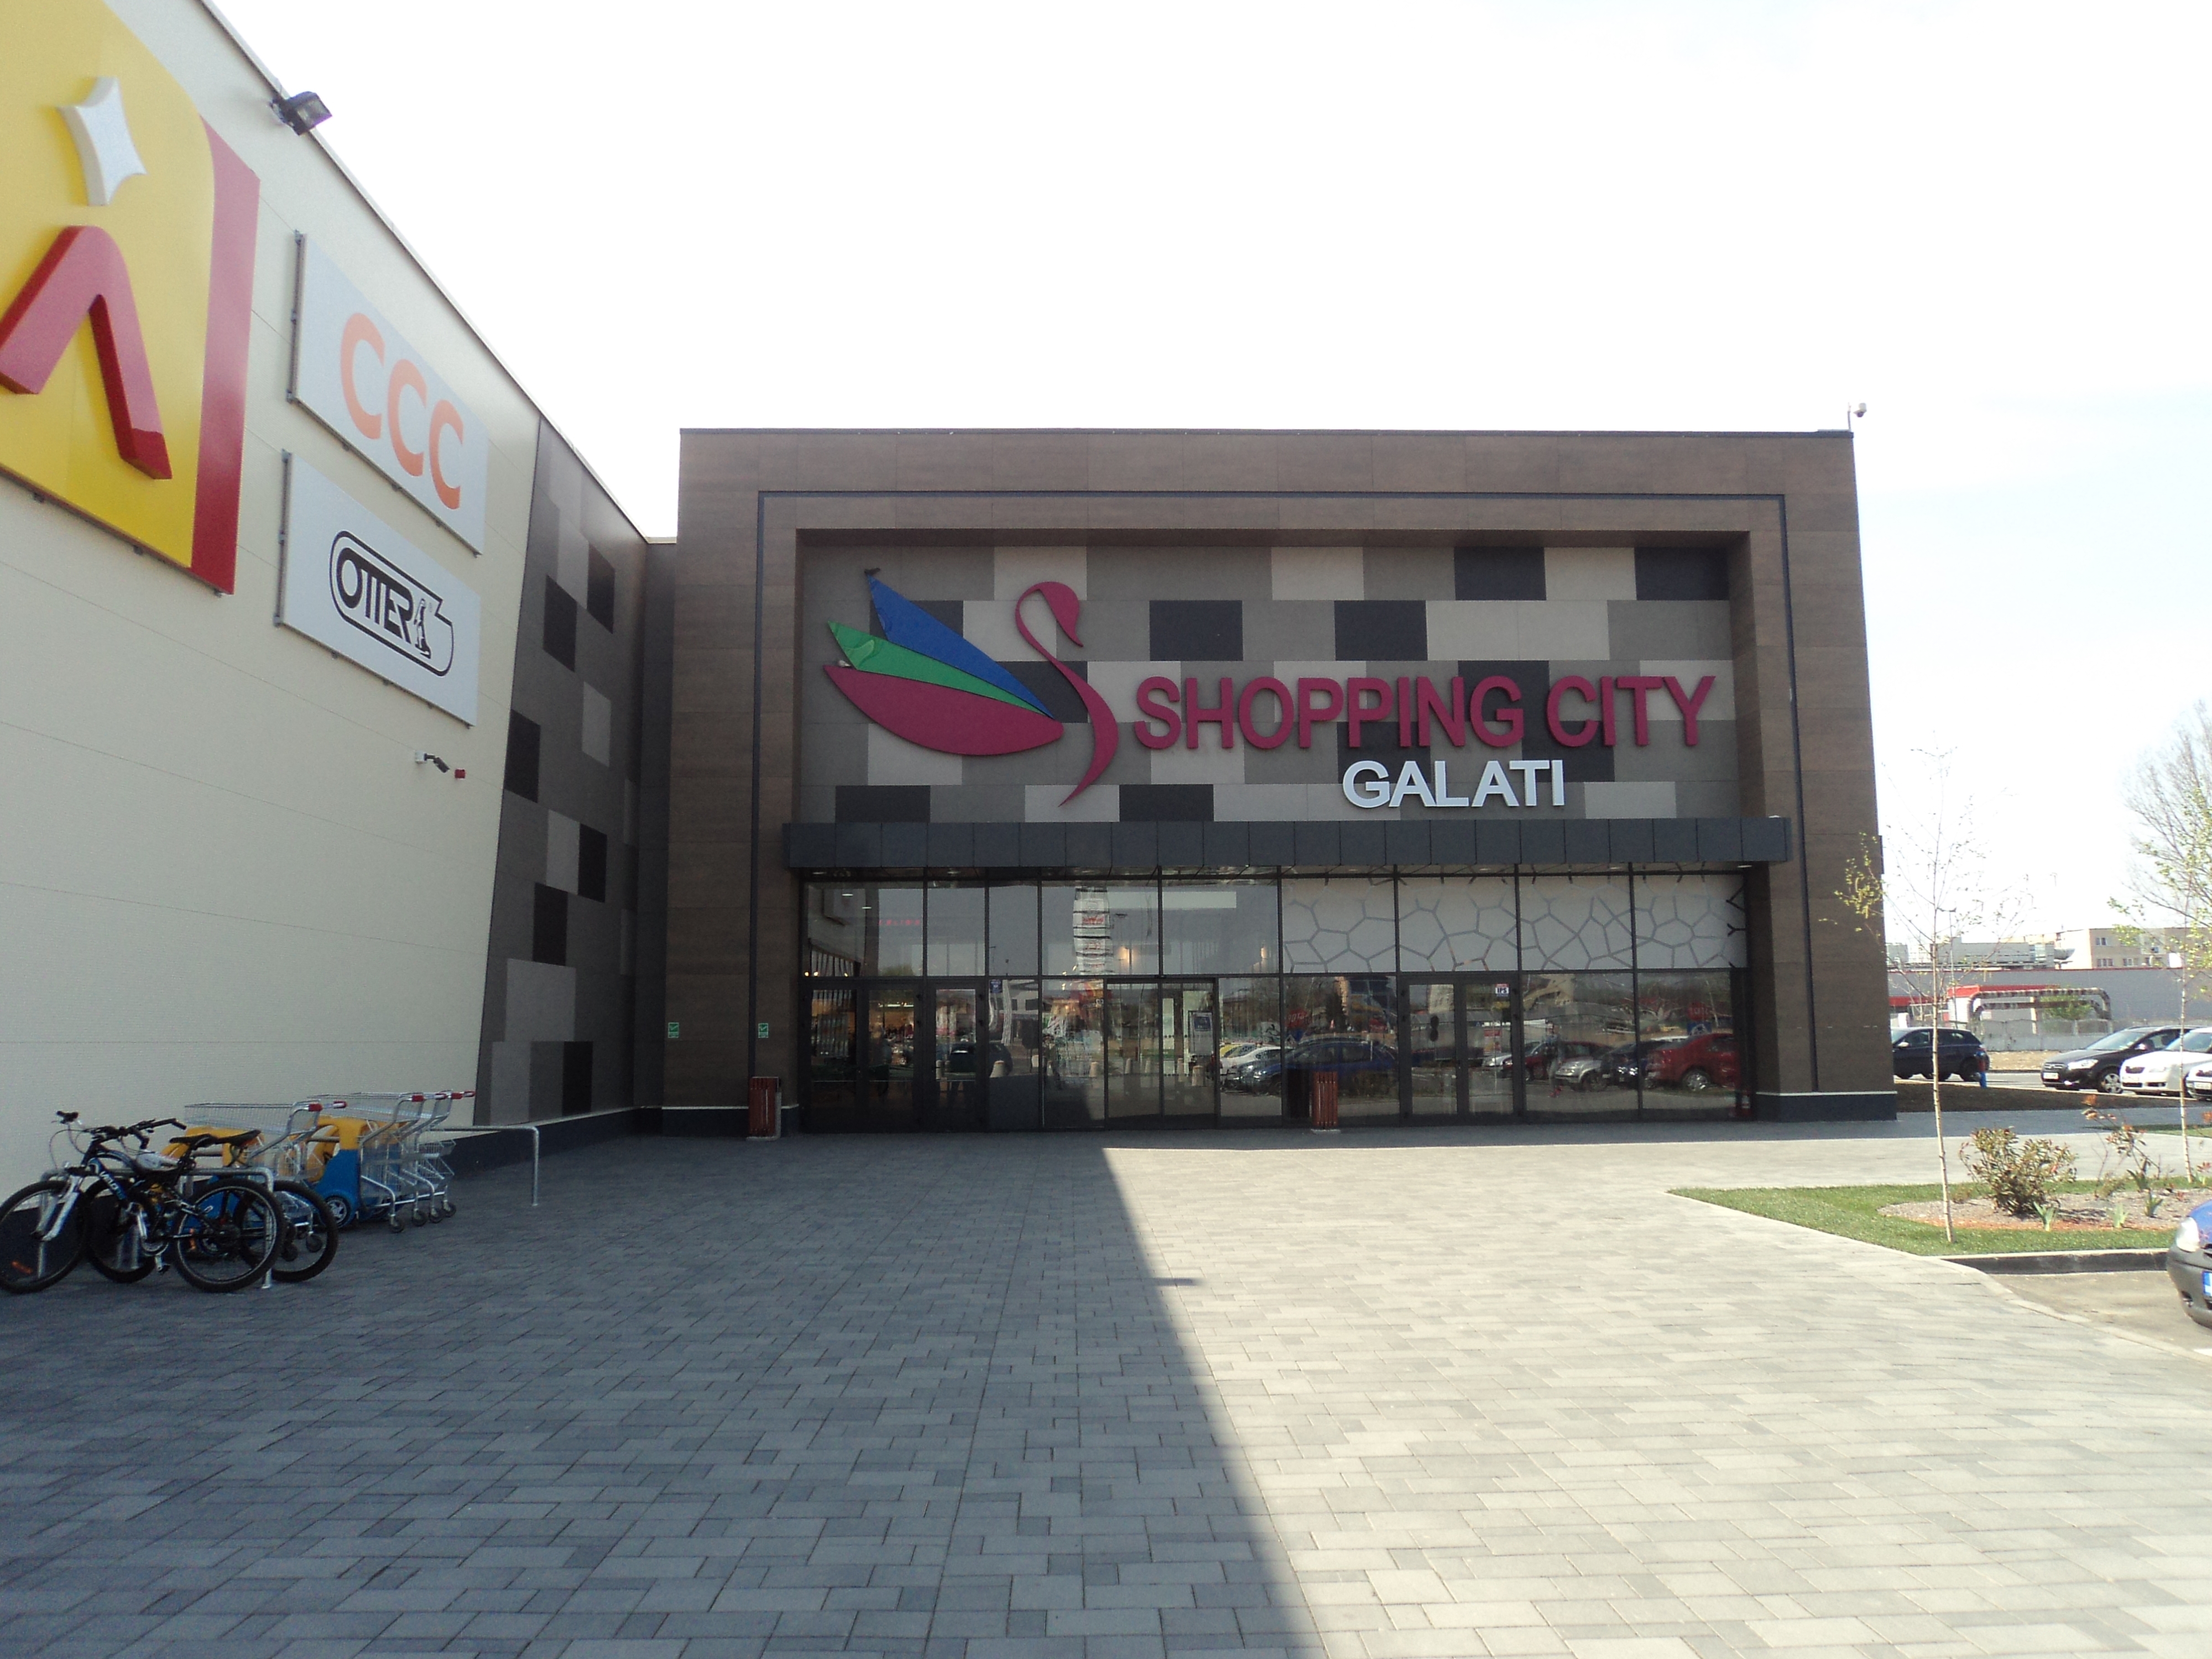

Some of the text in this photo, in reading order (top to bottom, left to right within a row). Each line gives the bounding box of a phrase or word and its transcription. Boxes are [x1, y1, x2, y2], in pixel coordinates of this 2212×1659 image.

[340, 312, 463, 509] CCC
[336, 547, 414, 644] OTTER
[1134, 675, 1715, 749] SHOPPING CITY
[1343, 760, 1565, 808] GALATI
